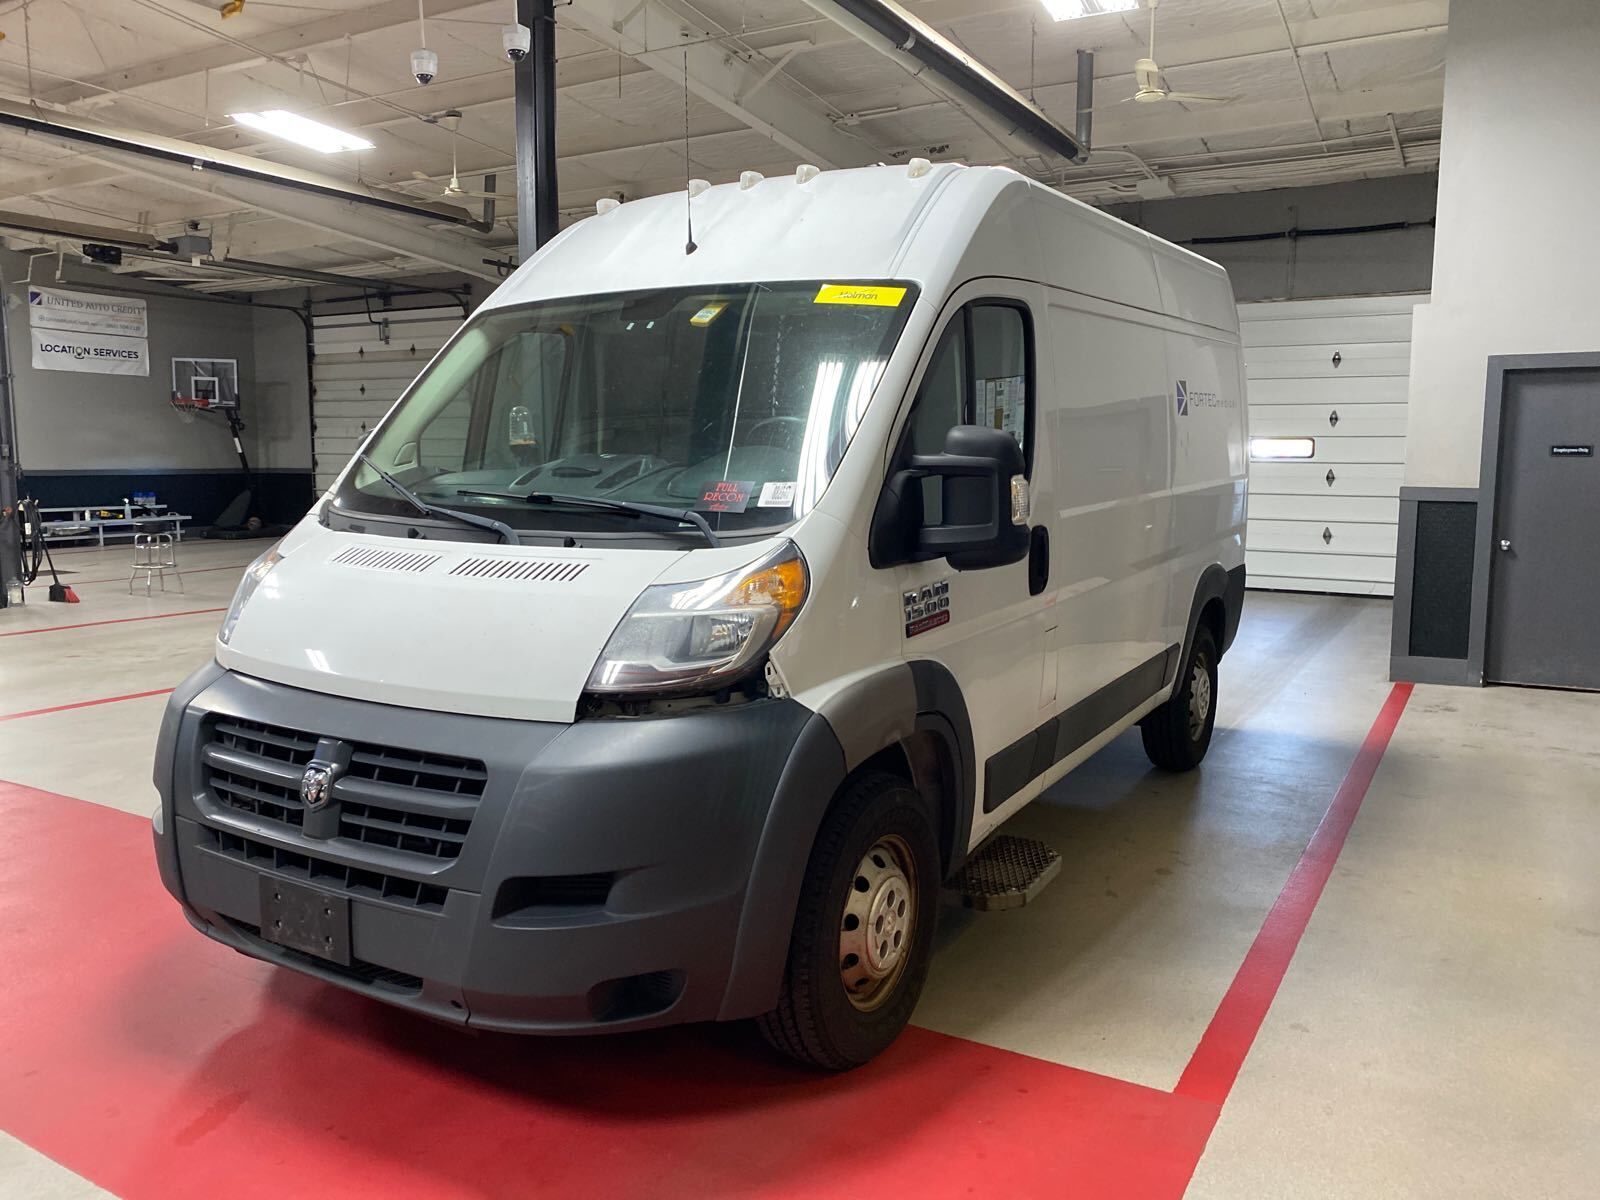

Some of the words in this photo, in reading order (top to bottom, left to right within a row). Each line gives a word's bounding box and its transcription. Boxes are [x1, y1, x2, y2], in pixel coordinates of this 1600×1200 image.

[47, 296, 83, 308] UNITED
[85, 301, 110, 312] AUTO
[111, 304, 142, 315] CREDIT
[40, 343, 90, 358] LOCATION
[93, 348, 139, 359] SERVICES
[715, 482, 737, 492] FULL
[903, 580, 949, 607] RAM
[904, 596, 949, 622] 1500
